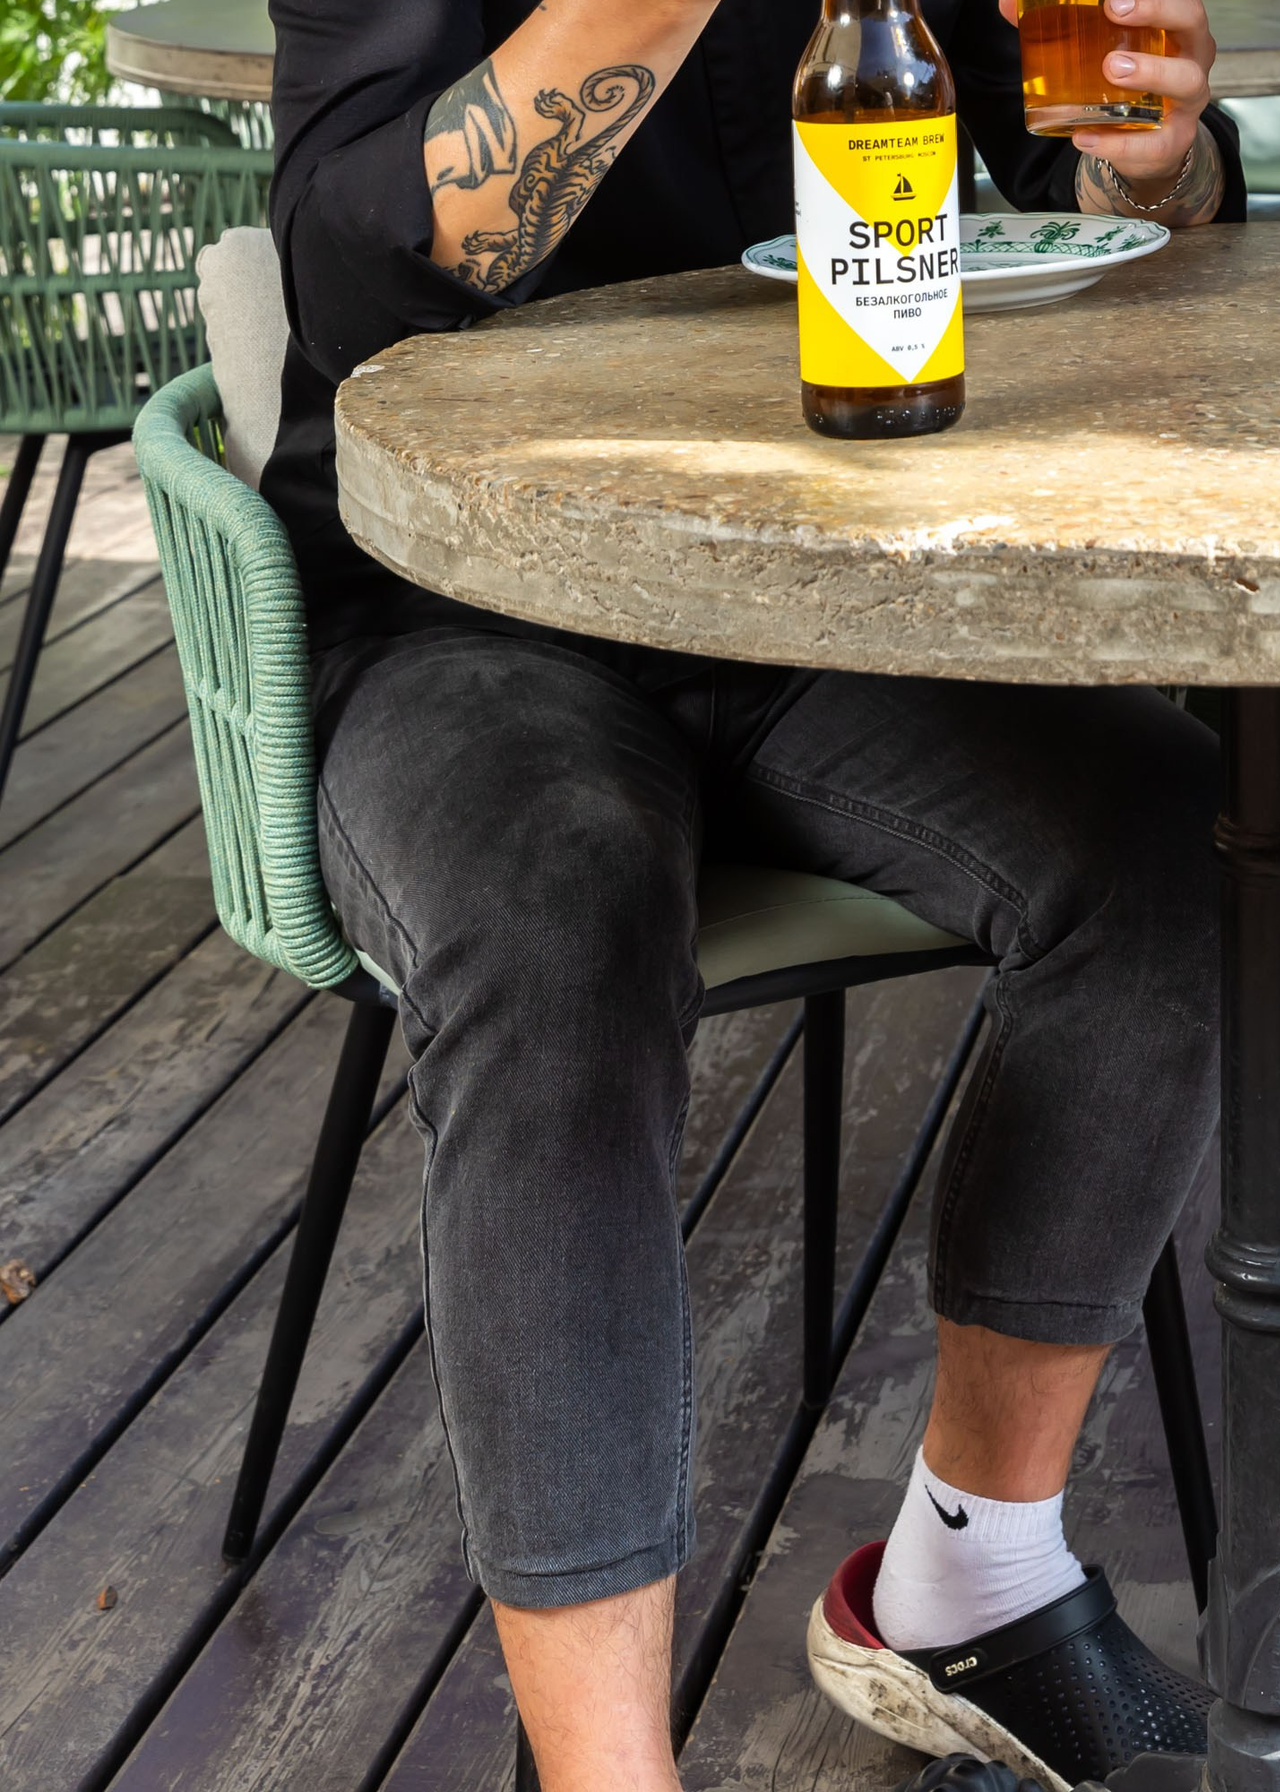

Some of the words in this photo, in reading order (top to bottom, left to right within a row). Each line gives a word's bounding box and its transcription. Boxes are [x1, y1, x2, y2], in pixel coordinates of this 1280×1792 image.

[848, 136, 918, 150] DREAMTEAM
[923, 133, 944, 145] BREW
[849, 213, 947, 249] SPORT
[831, 247, 959, 285] PILSNER
[856, 288, 948, 306] БЕЗАЛКОГОЛЬНОЕ
[893, 307, 922, 319] ПИВО
[945, 1657, 977, 1676] crocs
